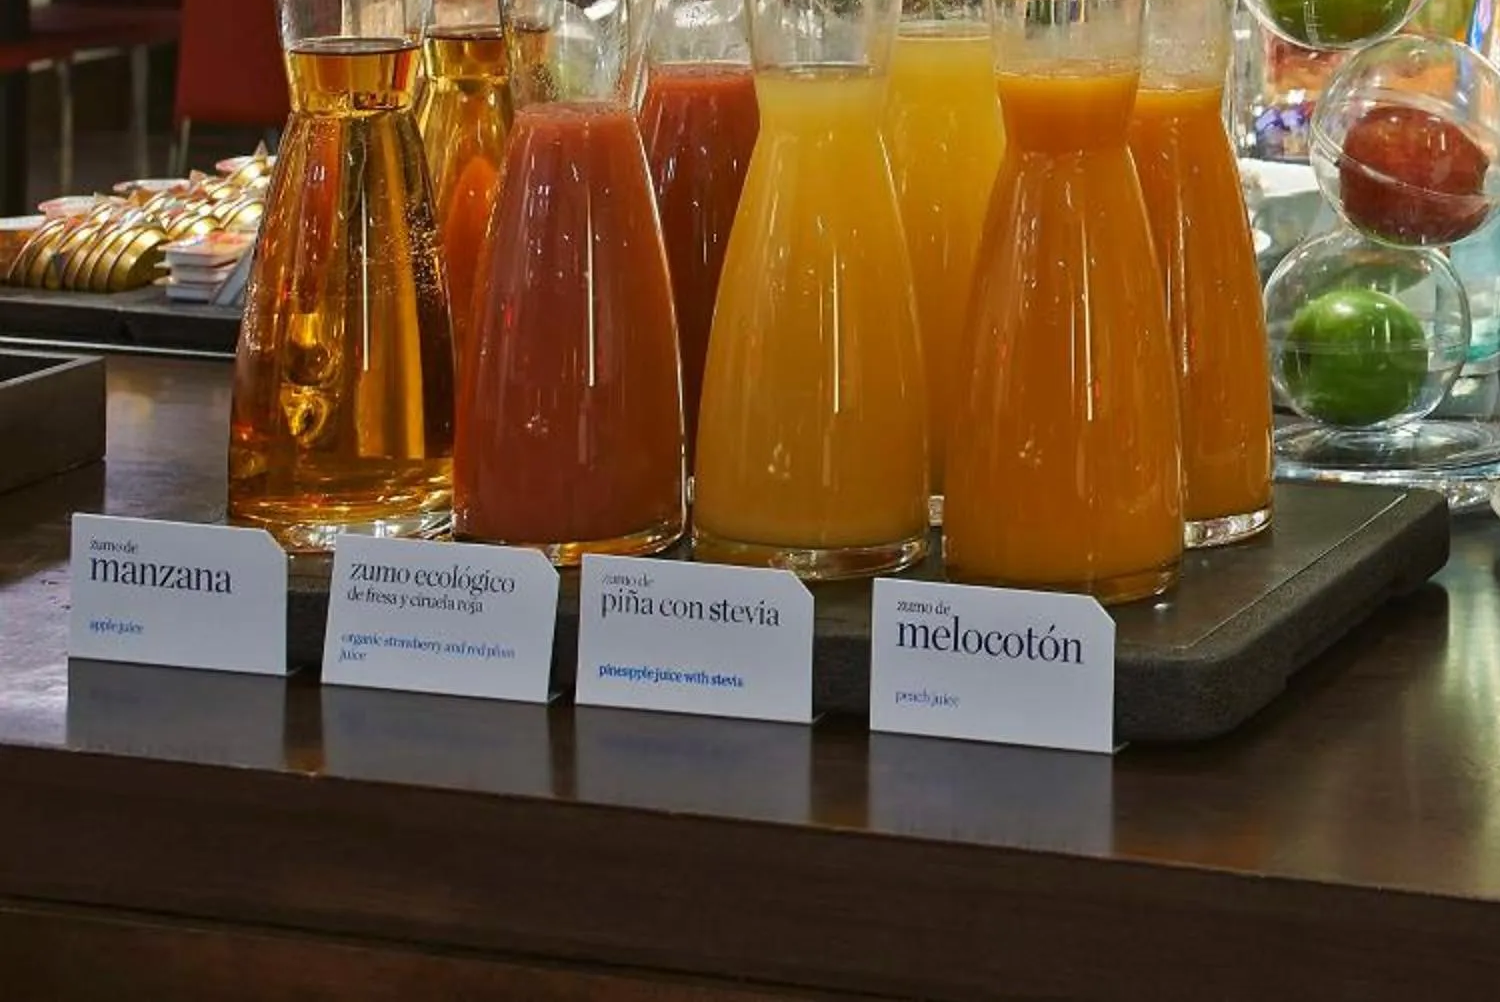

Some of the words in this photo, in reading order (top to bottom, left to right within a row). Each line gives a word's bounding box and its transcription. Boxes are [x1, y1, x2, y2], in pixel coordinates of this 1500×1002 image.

[90, 539, 122, 553] zumo
[123, 539, 138, 555] de
[89, 556, 233, 594] manzana
[350, 562, 411, 584] zumo
[414, 564, 515, 597] ecológico
[347, 585, 364, 601] de
[365, 586, 397, 605] fresa
[398, 595, 408, 609] y
[409, 594, 456, 612] ciruela
[457, 598, 483, 615] roja
[601, 588, 653, 618] piña
[658, 598, 703, 621] con
[708, 598, 781, 627] stevia
[896, 600, 932, 615] zumo
[934, 600, 951, 616] de
[89, 616, 116, 634] apple
[117, 619, 144, 635] juice
[341, 633, 382, 648] organic
[384, 634, 442, 655] strawberry
[444, 641, 465, 655] and
[466, 643, 486, 657] red
[896, 615, 1084, 665] melocotón
[338, 649, 367, 663] juice
[598, 663, 652, 682] pineapple
[653, 667, 684, 683] juice
[685, 670, 709, 685] with
[711, 673, 743, 688] stevia
[895, 687, 931, 705] peach
[931, 690, 960, 708] juice
